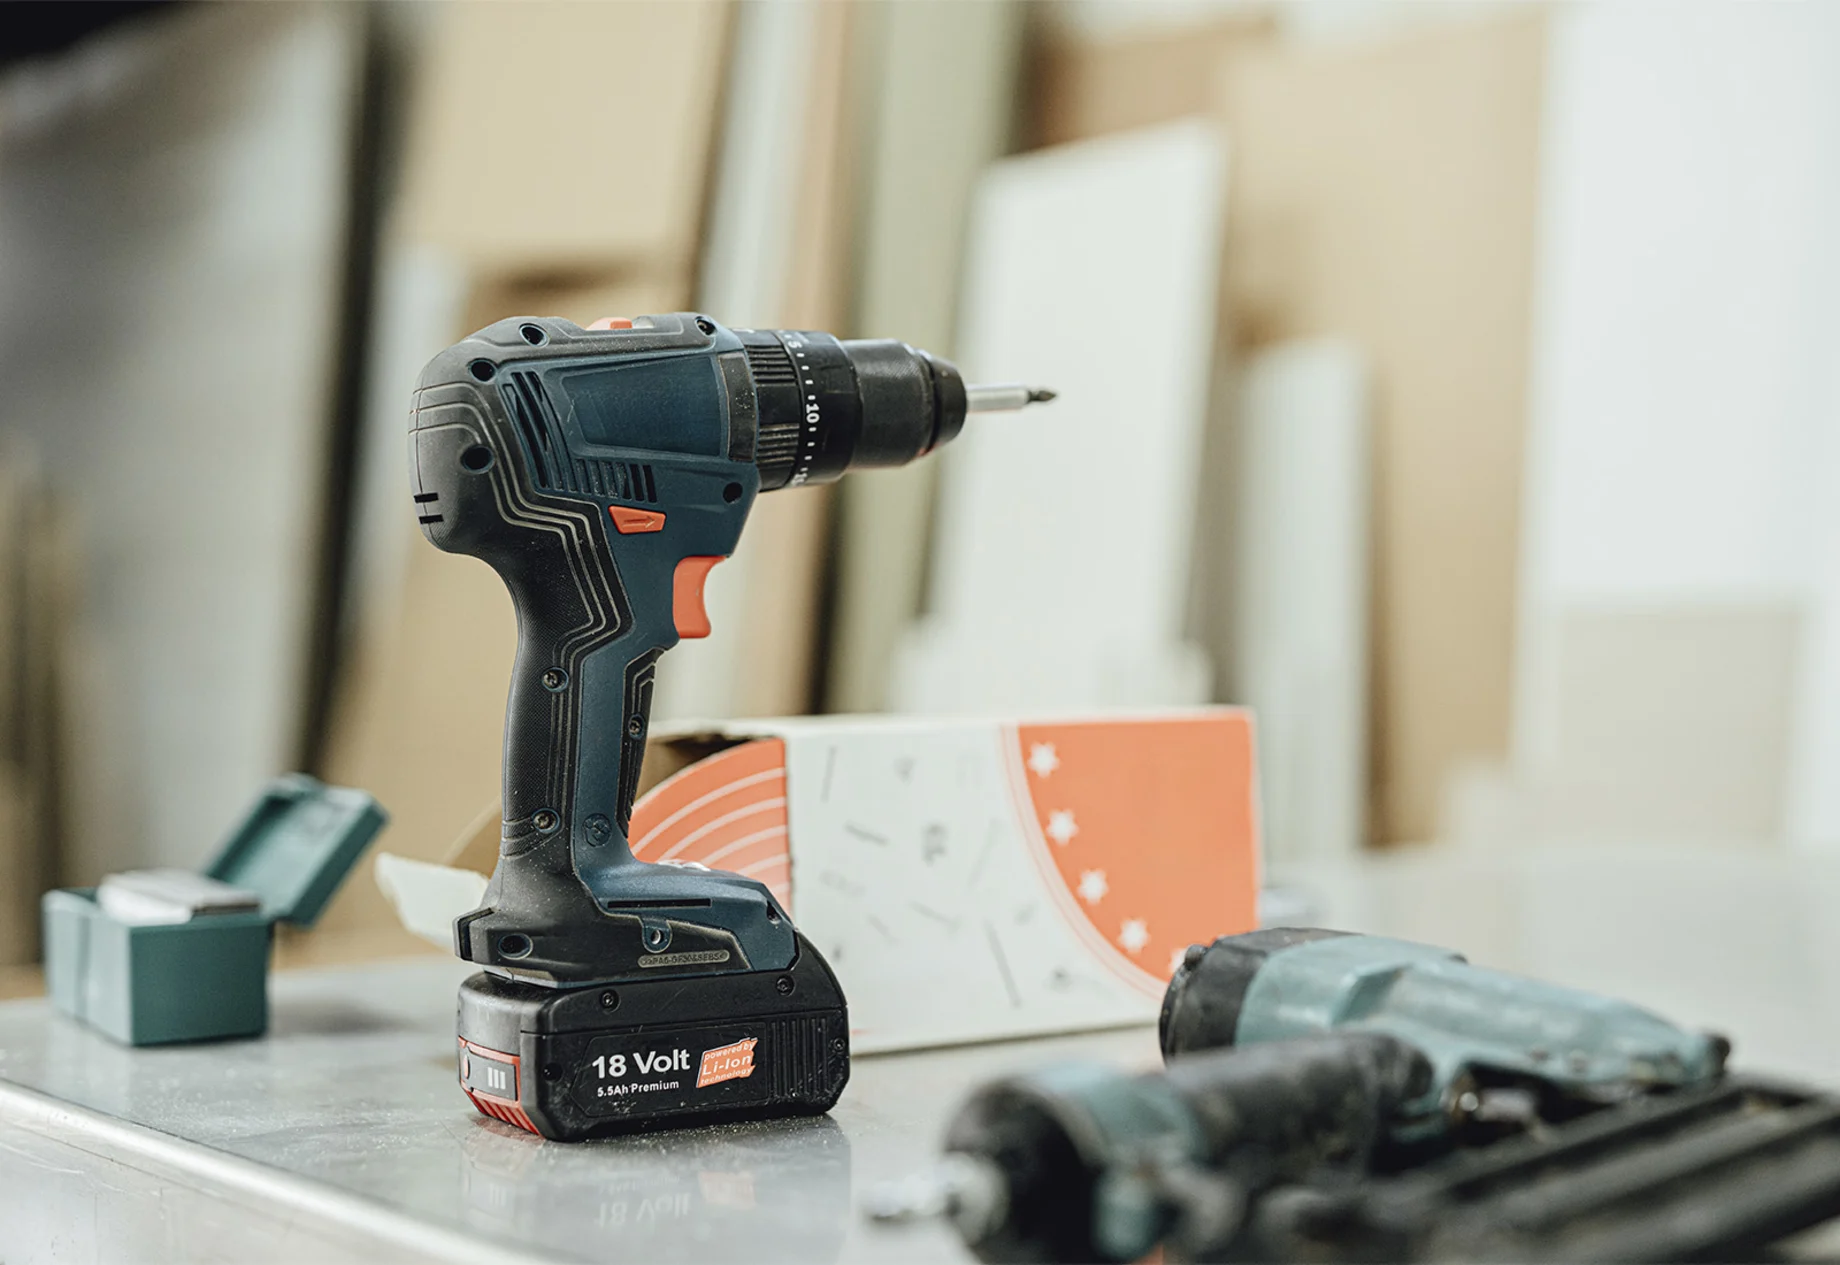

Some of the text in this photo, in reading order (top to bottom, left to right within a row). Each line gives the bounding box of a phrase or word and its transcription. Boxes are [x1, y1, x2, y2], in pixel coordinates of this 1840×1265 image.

[805, 403, 820, 423] 10
[704, 1041, 755, 1063] powered by
[592, 1049, 690, 1079] 18 Volt
[702, 1055, 751, 1076] Li-Ion
[701, 1068, 752, 1085] technology
[597, 1080, 679, 1097] 5.5Ah Premium
